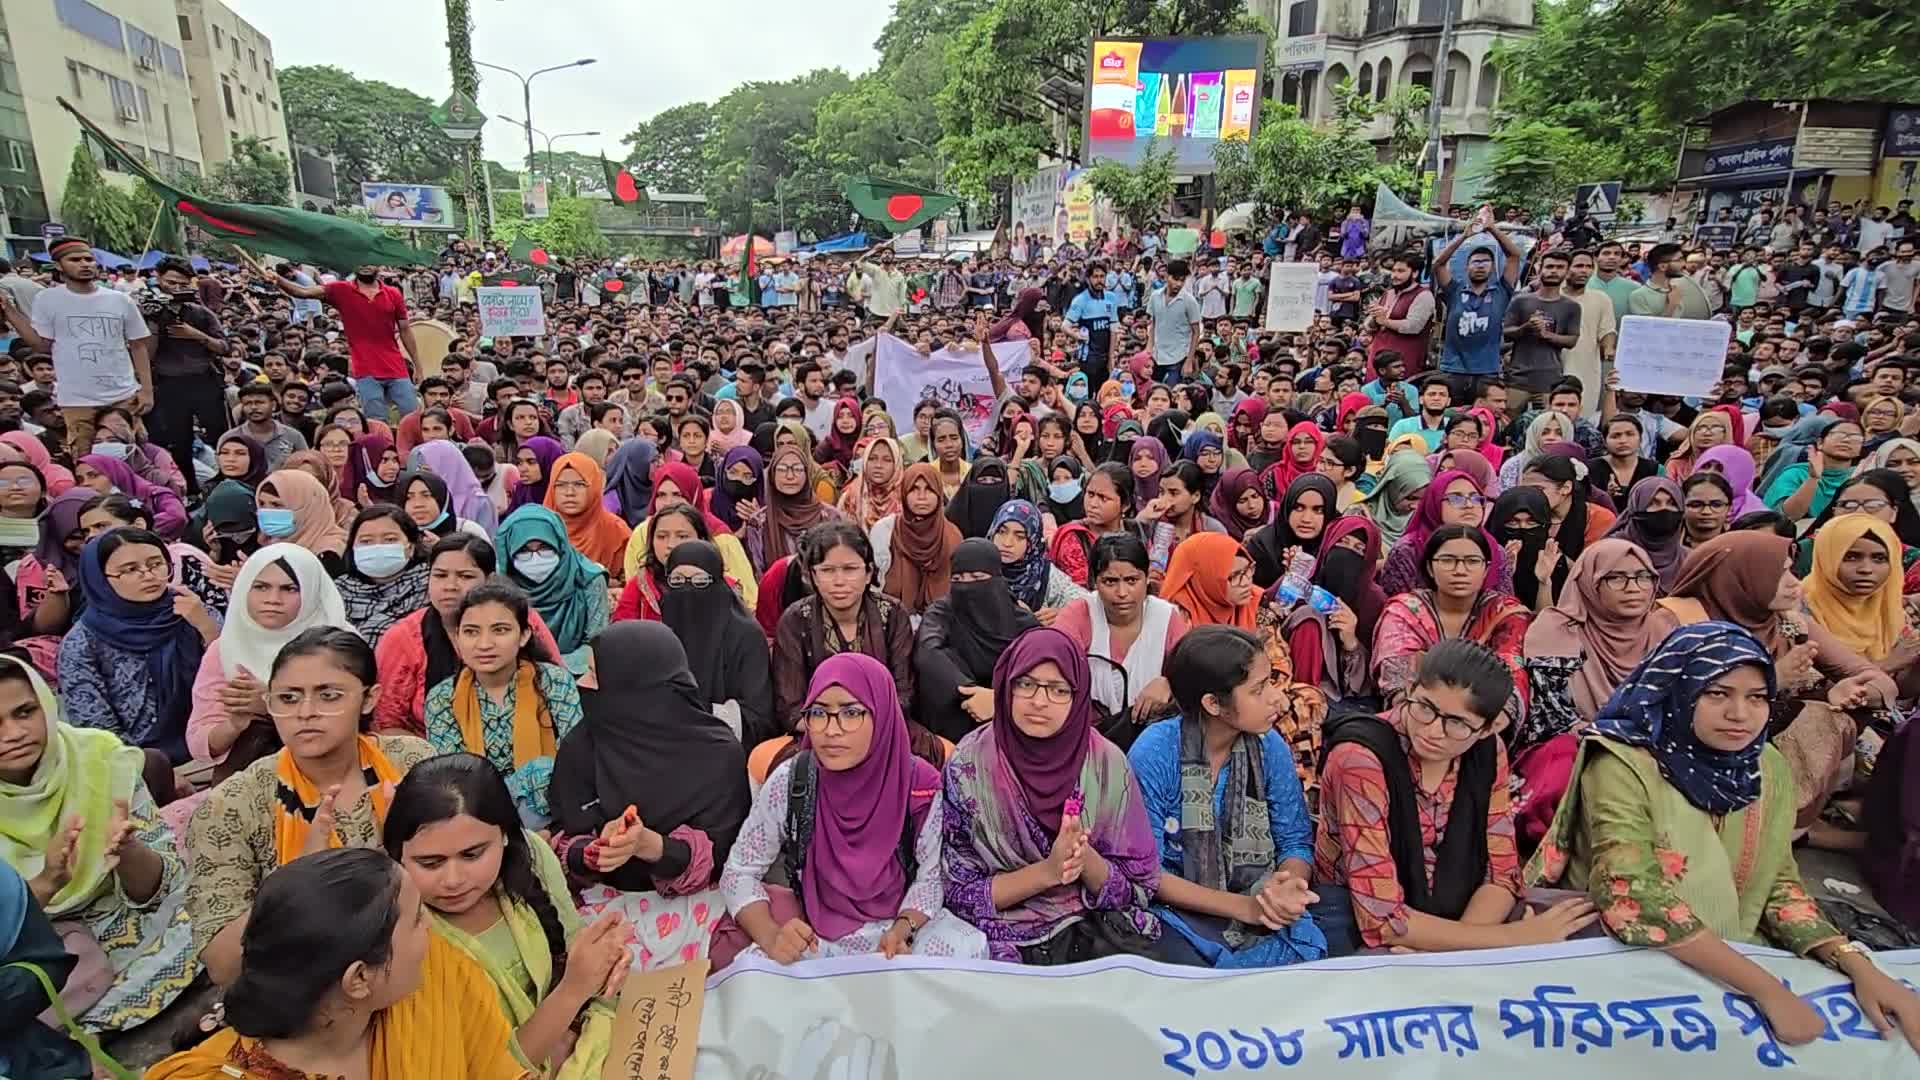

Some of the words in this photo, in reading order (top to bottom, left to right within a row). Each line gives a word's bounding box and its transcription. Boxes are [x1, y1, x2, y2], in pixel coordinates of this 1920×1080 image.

[1160, 1025, 1305, 1078] ২০১৮
[1324, 1004, 1480, 1058] সালের
[1499, 984, 1718, 1051] পরিপত্র
